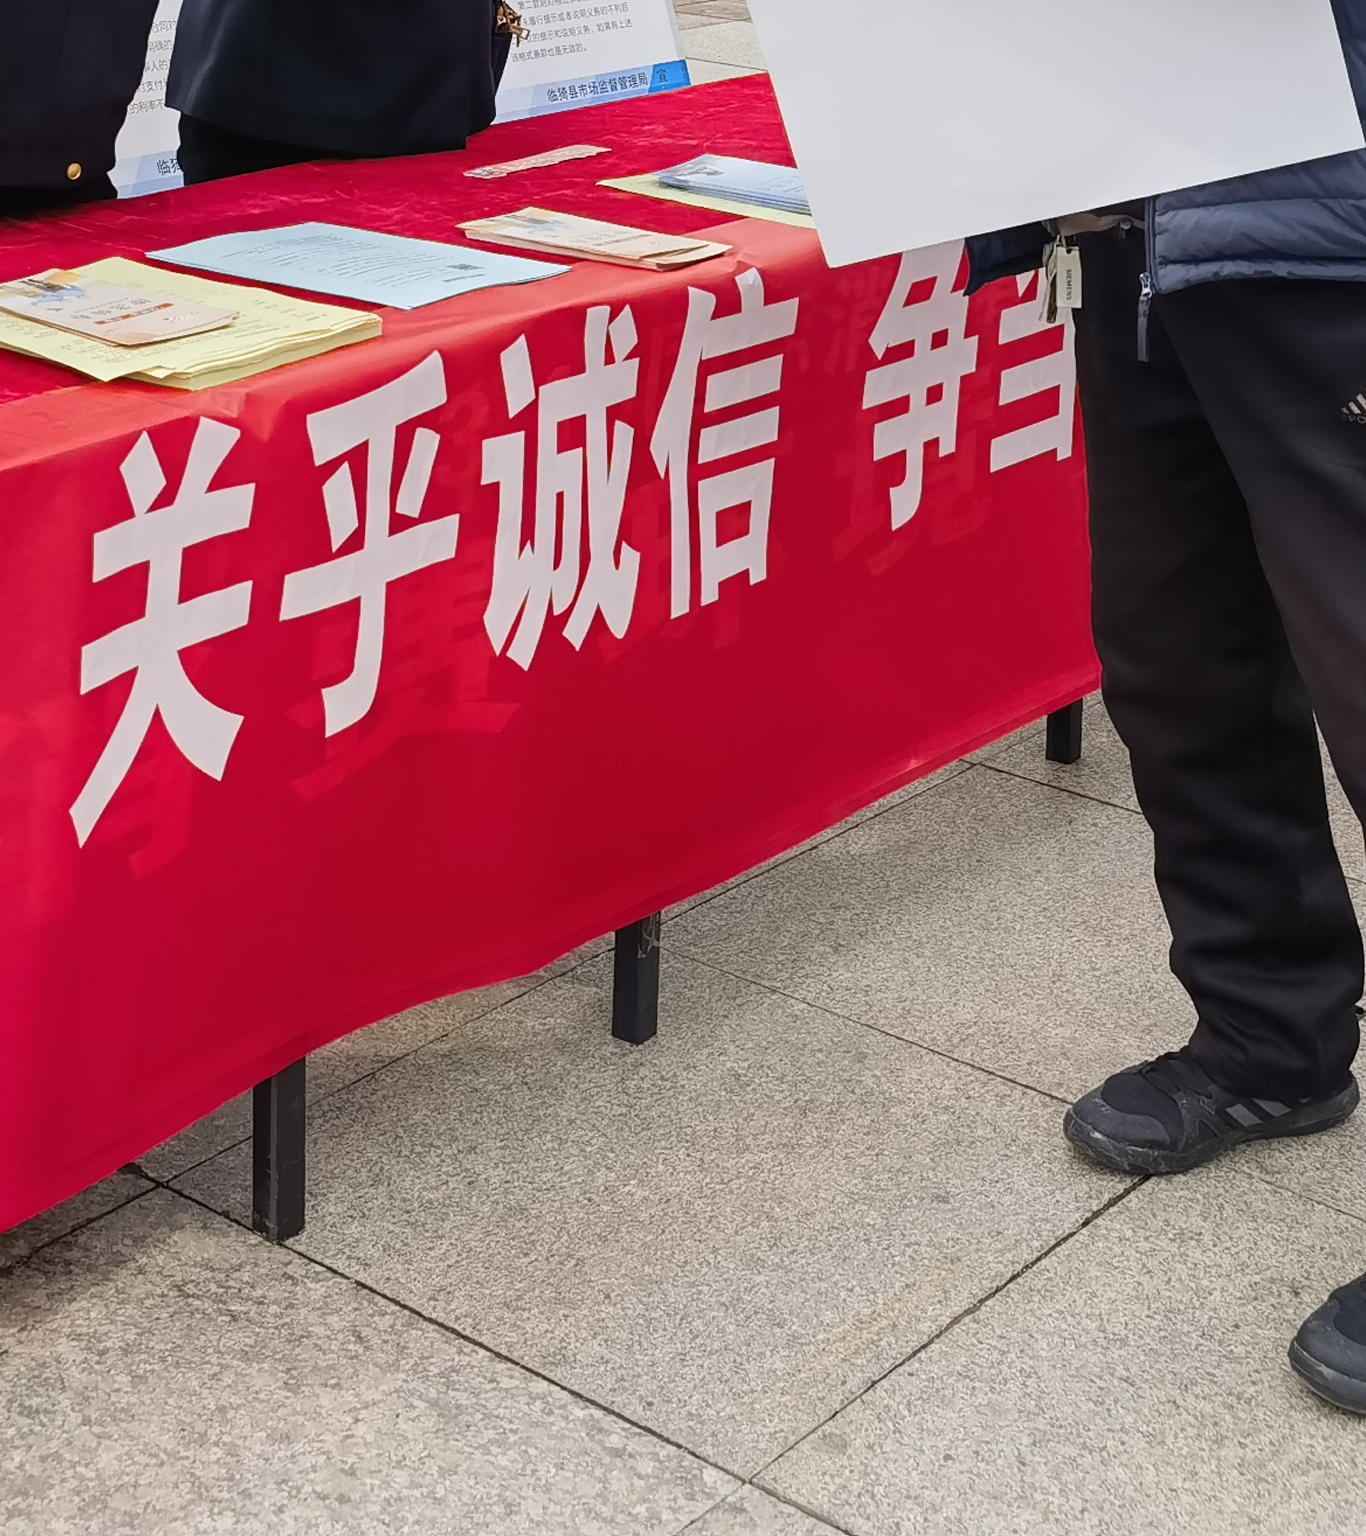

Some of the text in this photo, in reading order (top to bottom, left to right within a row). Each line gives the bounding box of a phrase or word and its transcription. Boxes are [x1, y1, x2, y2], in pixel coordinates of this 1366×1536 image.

[546, 71, 649, 102] 临猗县市场监督管理局
[68, 265, 799, 848] 关乎诚信
